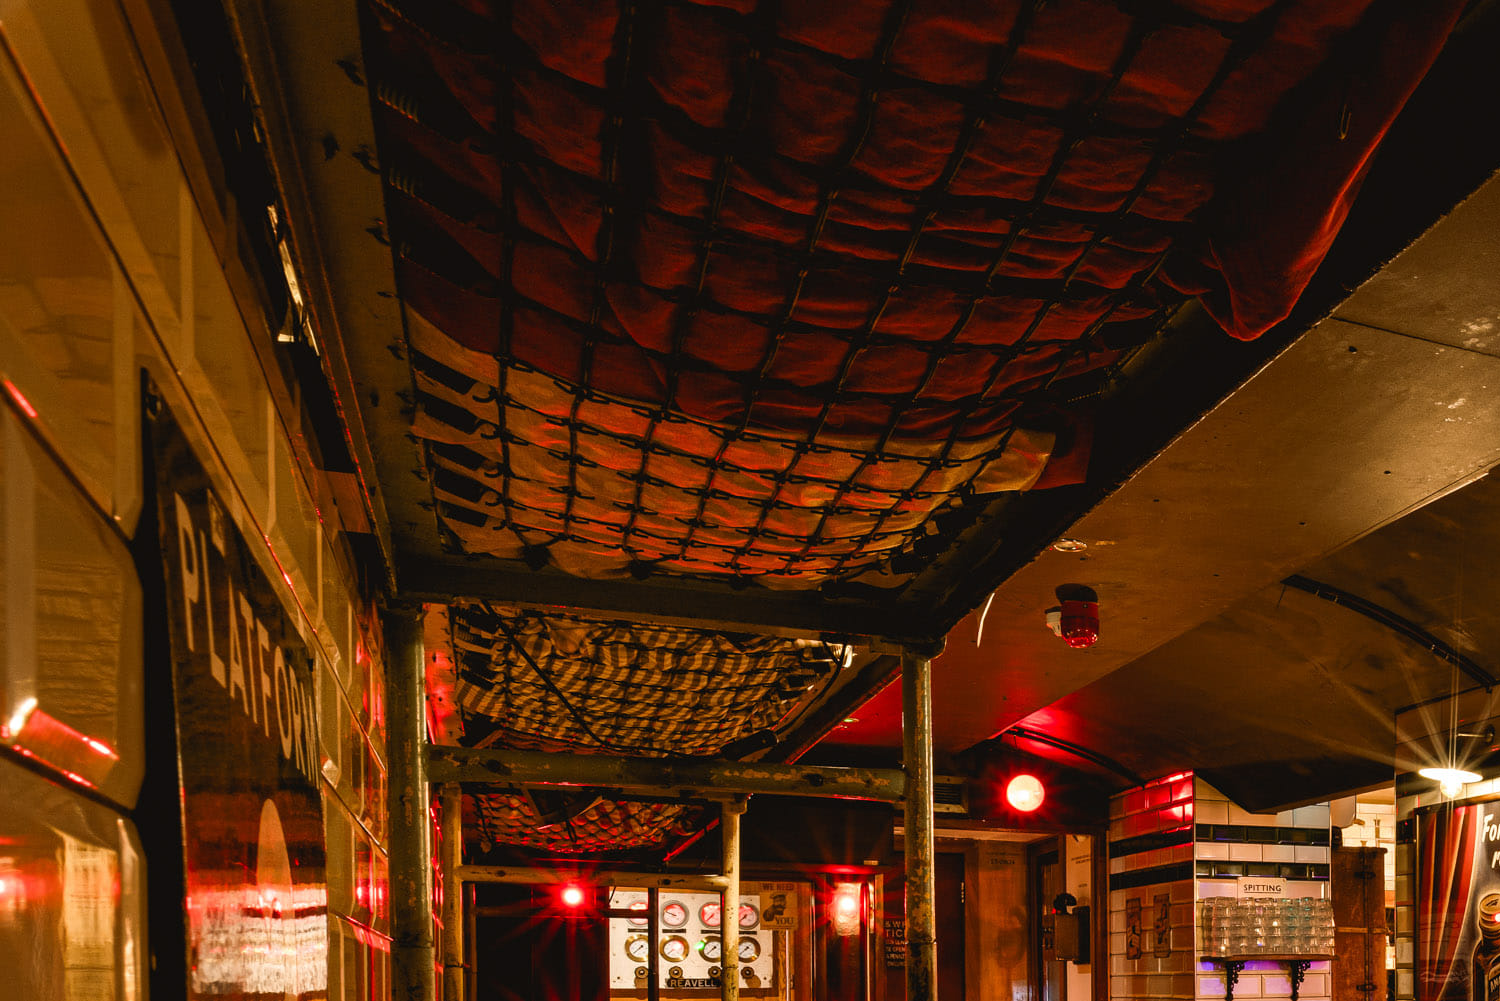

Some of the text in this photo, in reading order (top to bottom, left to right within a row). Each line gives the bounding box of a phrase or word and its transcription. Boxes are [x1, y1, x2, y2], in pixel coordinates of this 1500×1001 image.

[175, 490, 319, 791] PLATFORM
[1243, 884, 1282, 892] SPITTING
[670, 979, 715, 987] REAVELL
